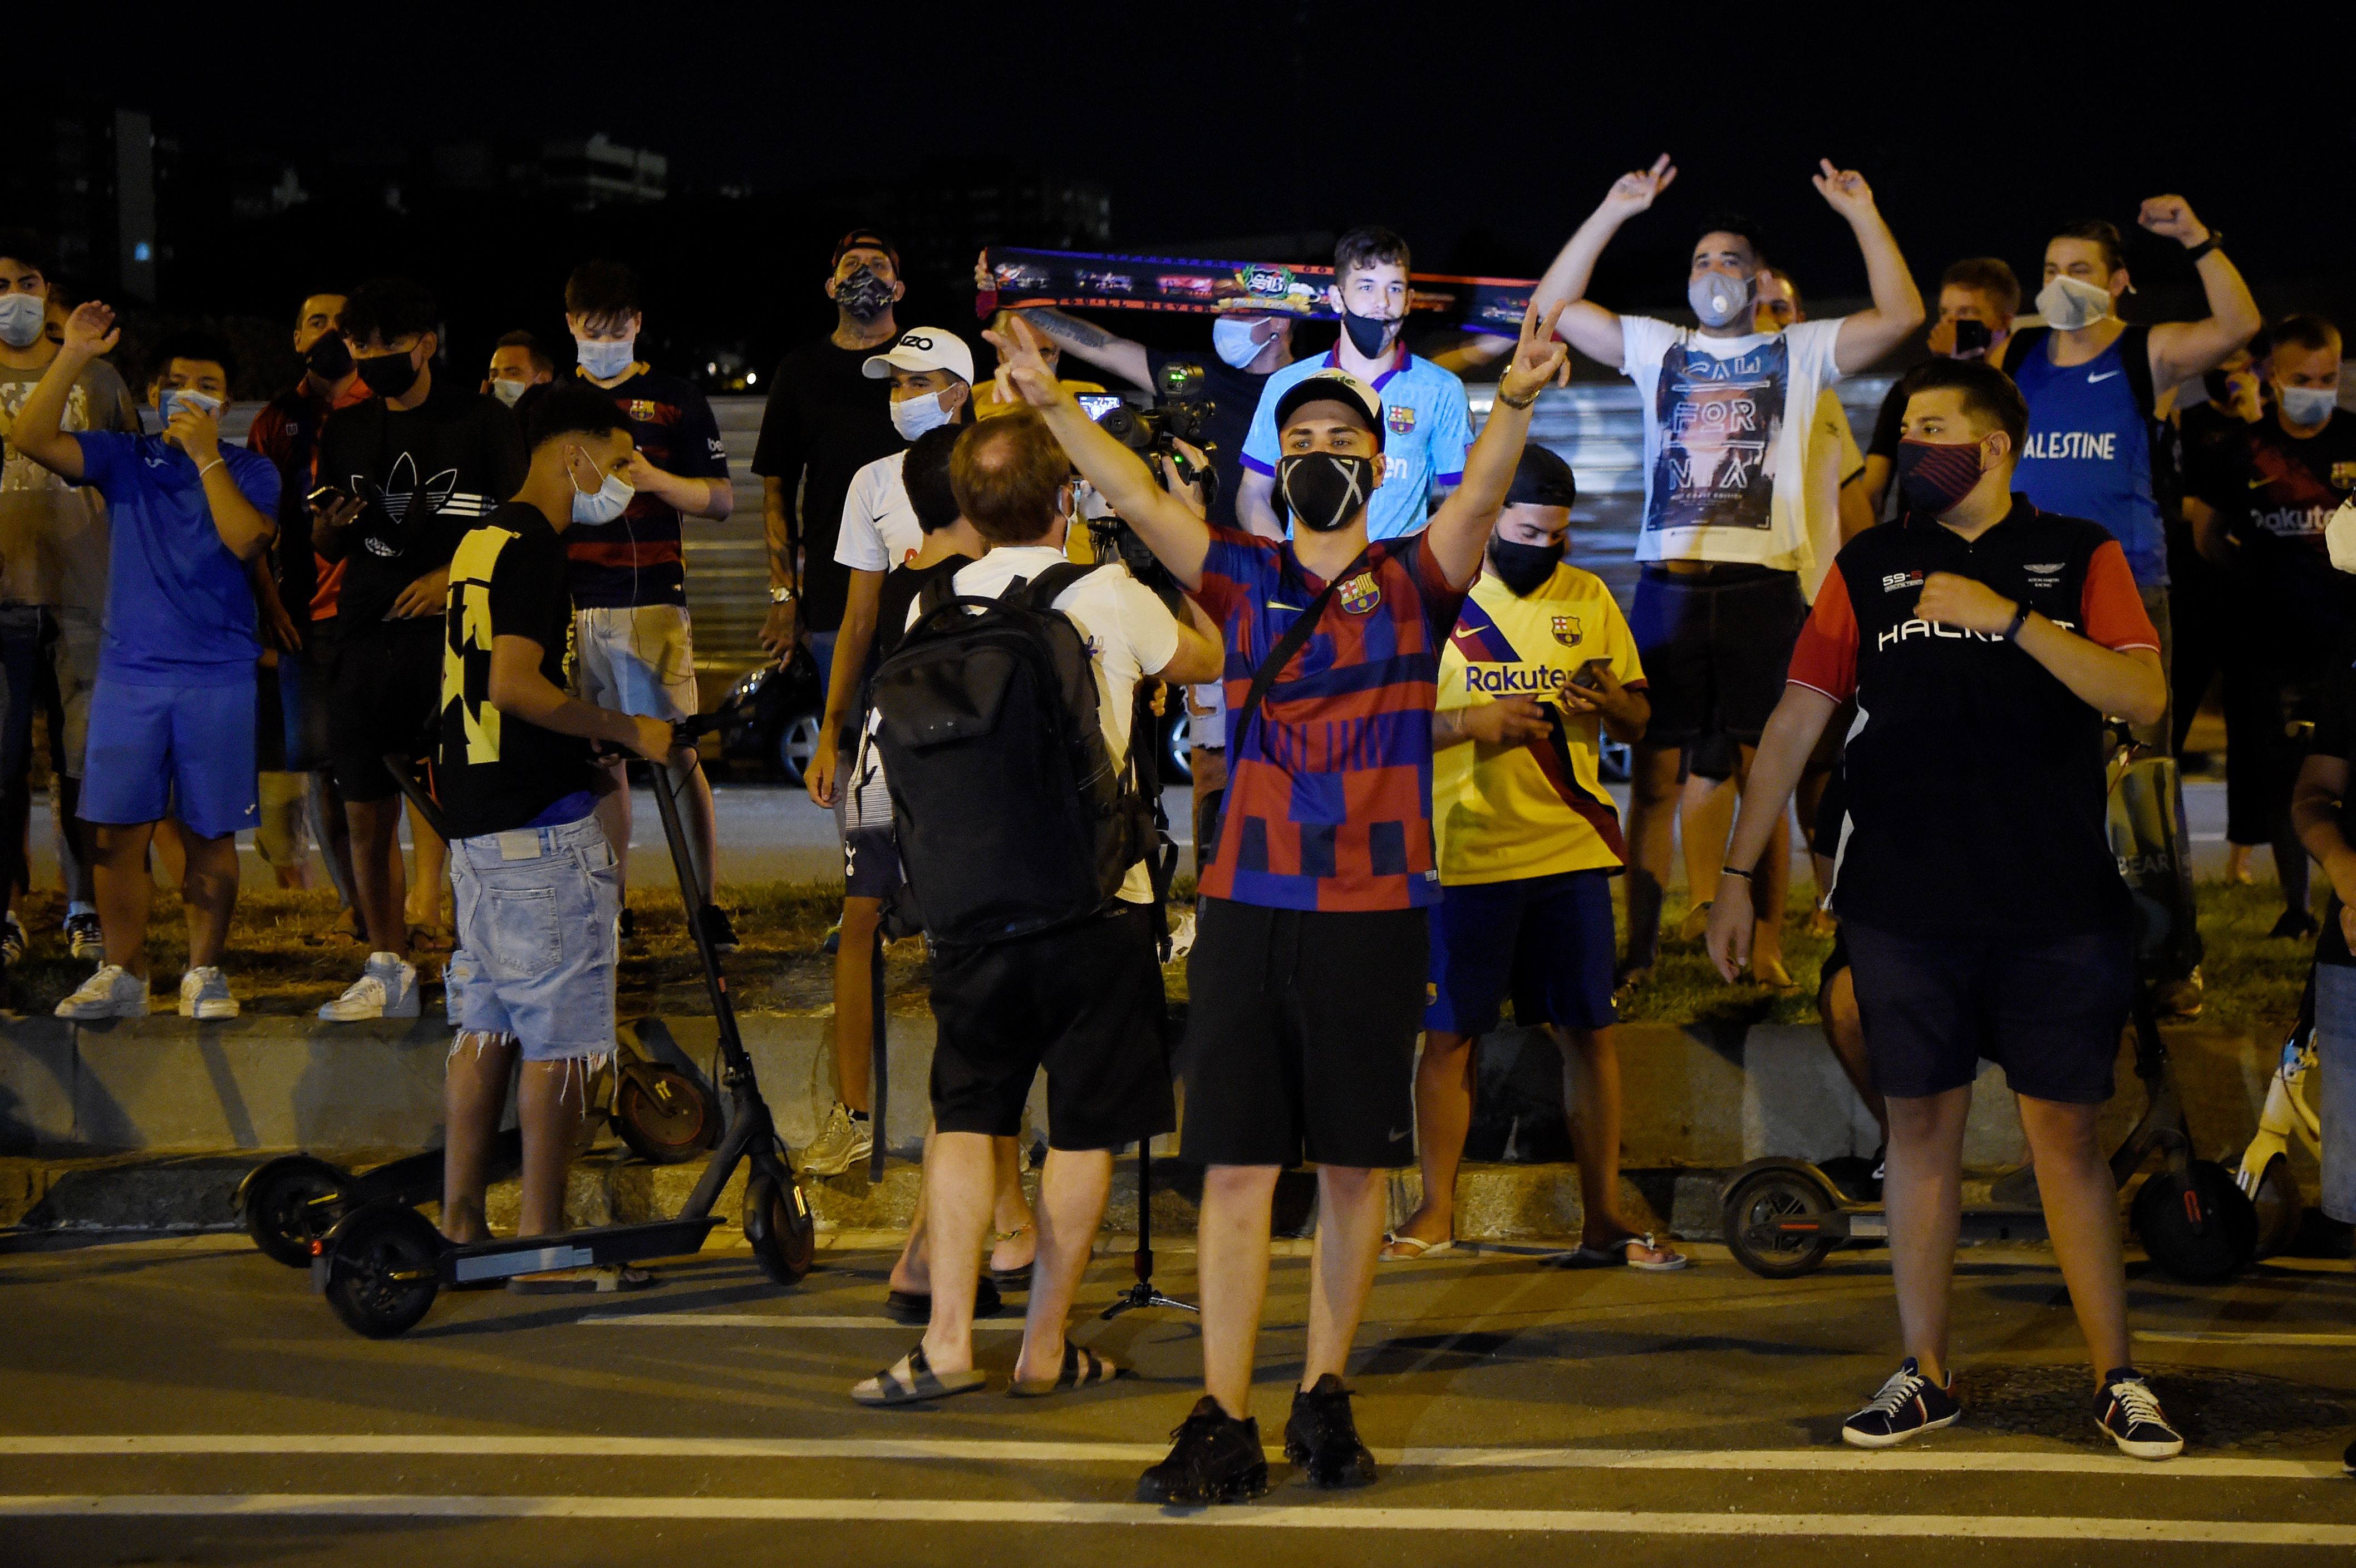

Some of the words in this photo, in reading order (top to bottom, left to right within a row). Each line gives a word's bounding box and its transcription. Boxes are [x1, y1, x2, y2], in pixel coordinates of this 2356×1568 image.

[1673, 398, 1757, 433] FOR
[2023, 431, 2116, 460] ALESTINE
[1466, 665, 1572, 691] Rakute
